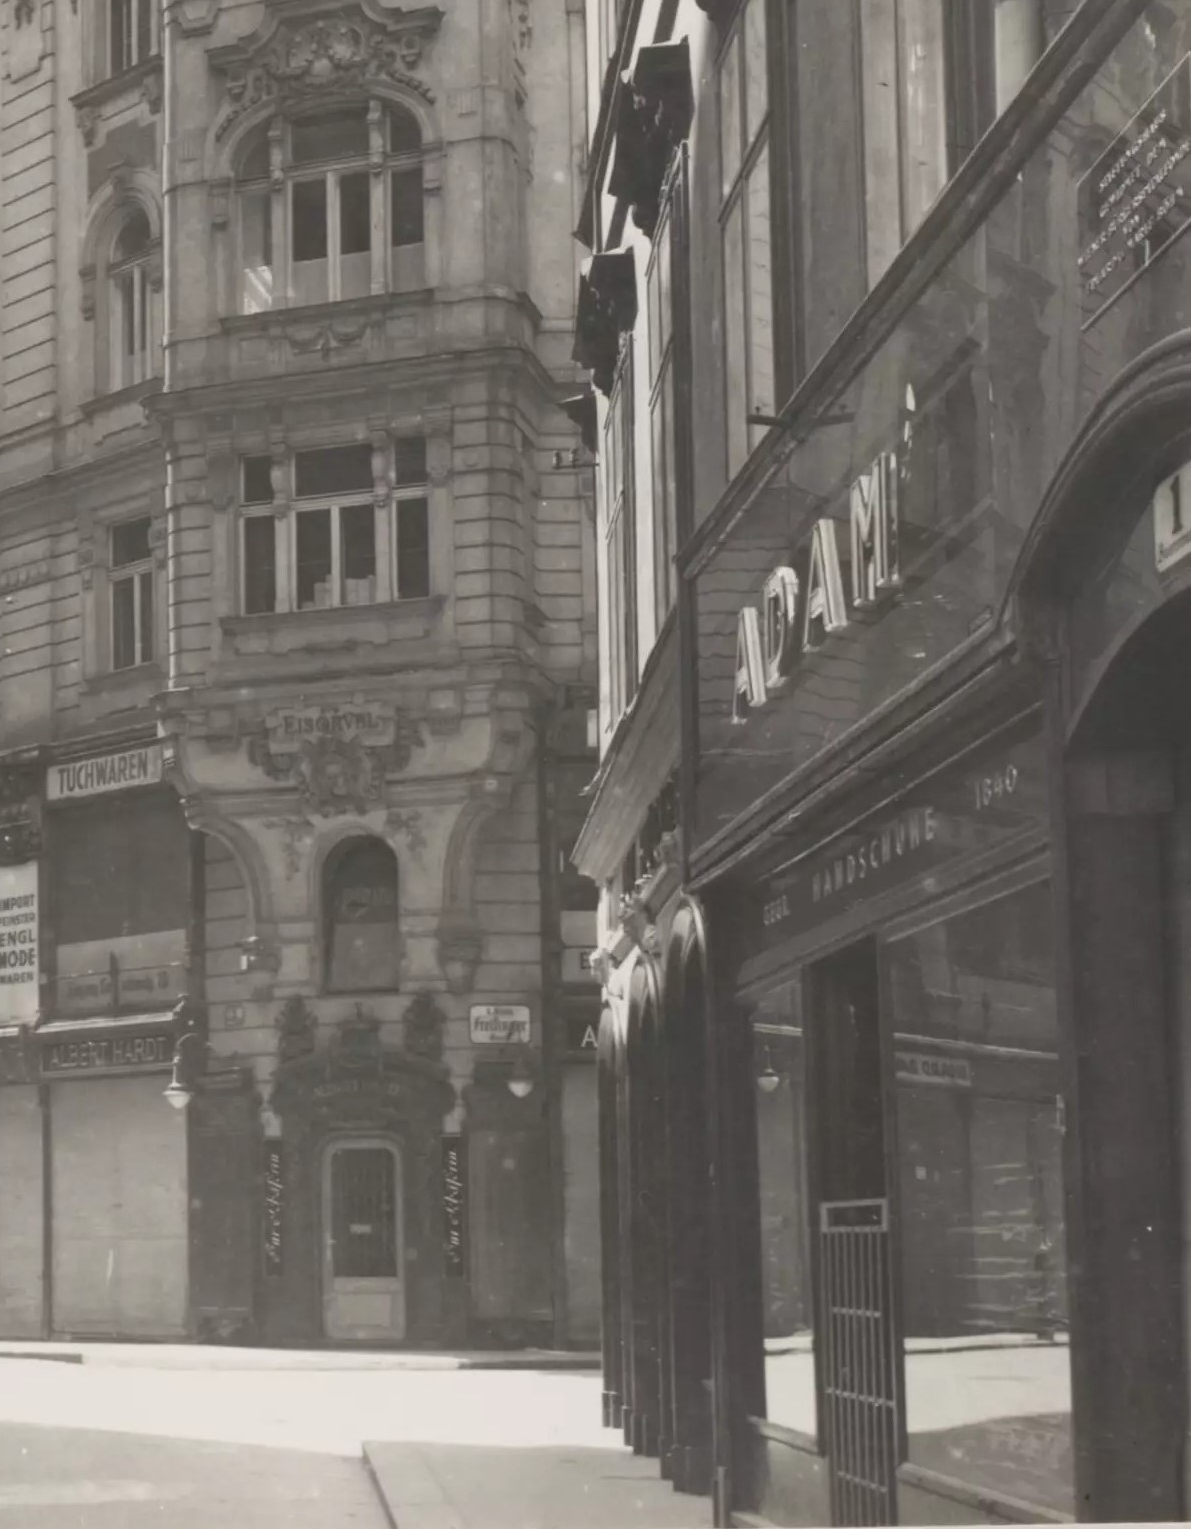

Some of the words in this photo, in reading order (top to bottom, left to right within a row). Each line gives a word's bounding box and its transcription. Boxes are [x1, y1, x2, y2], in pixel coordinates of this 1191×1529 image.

[731, 451, 900, 725] ADAM
[57, 750, 149, 795] TUCHWAREN
[113, 1036, 167, 1063] HARDT
